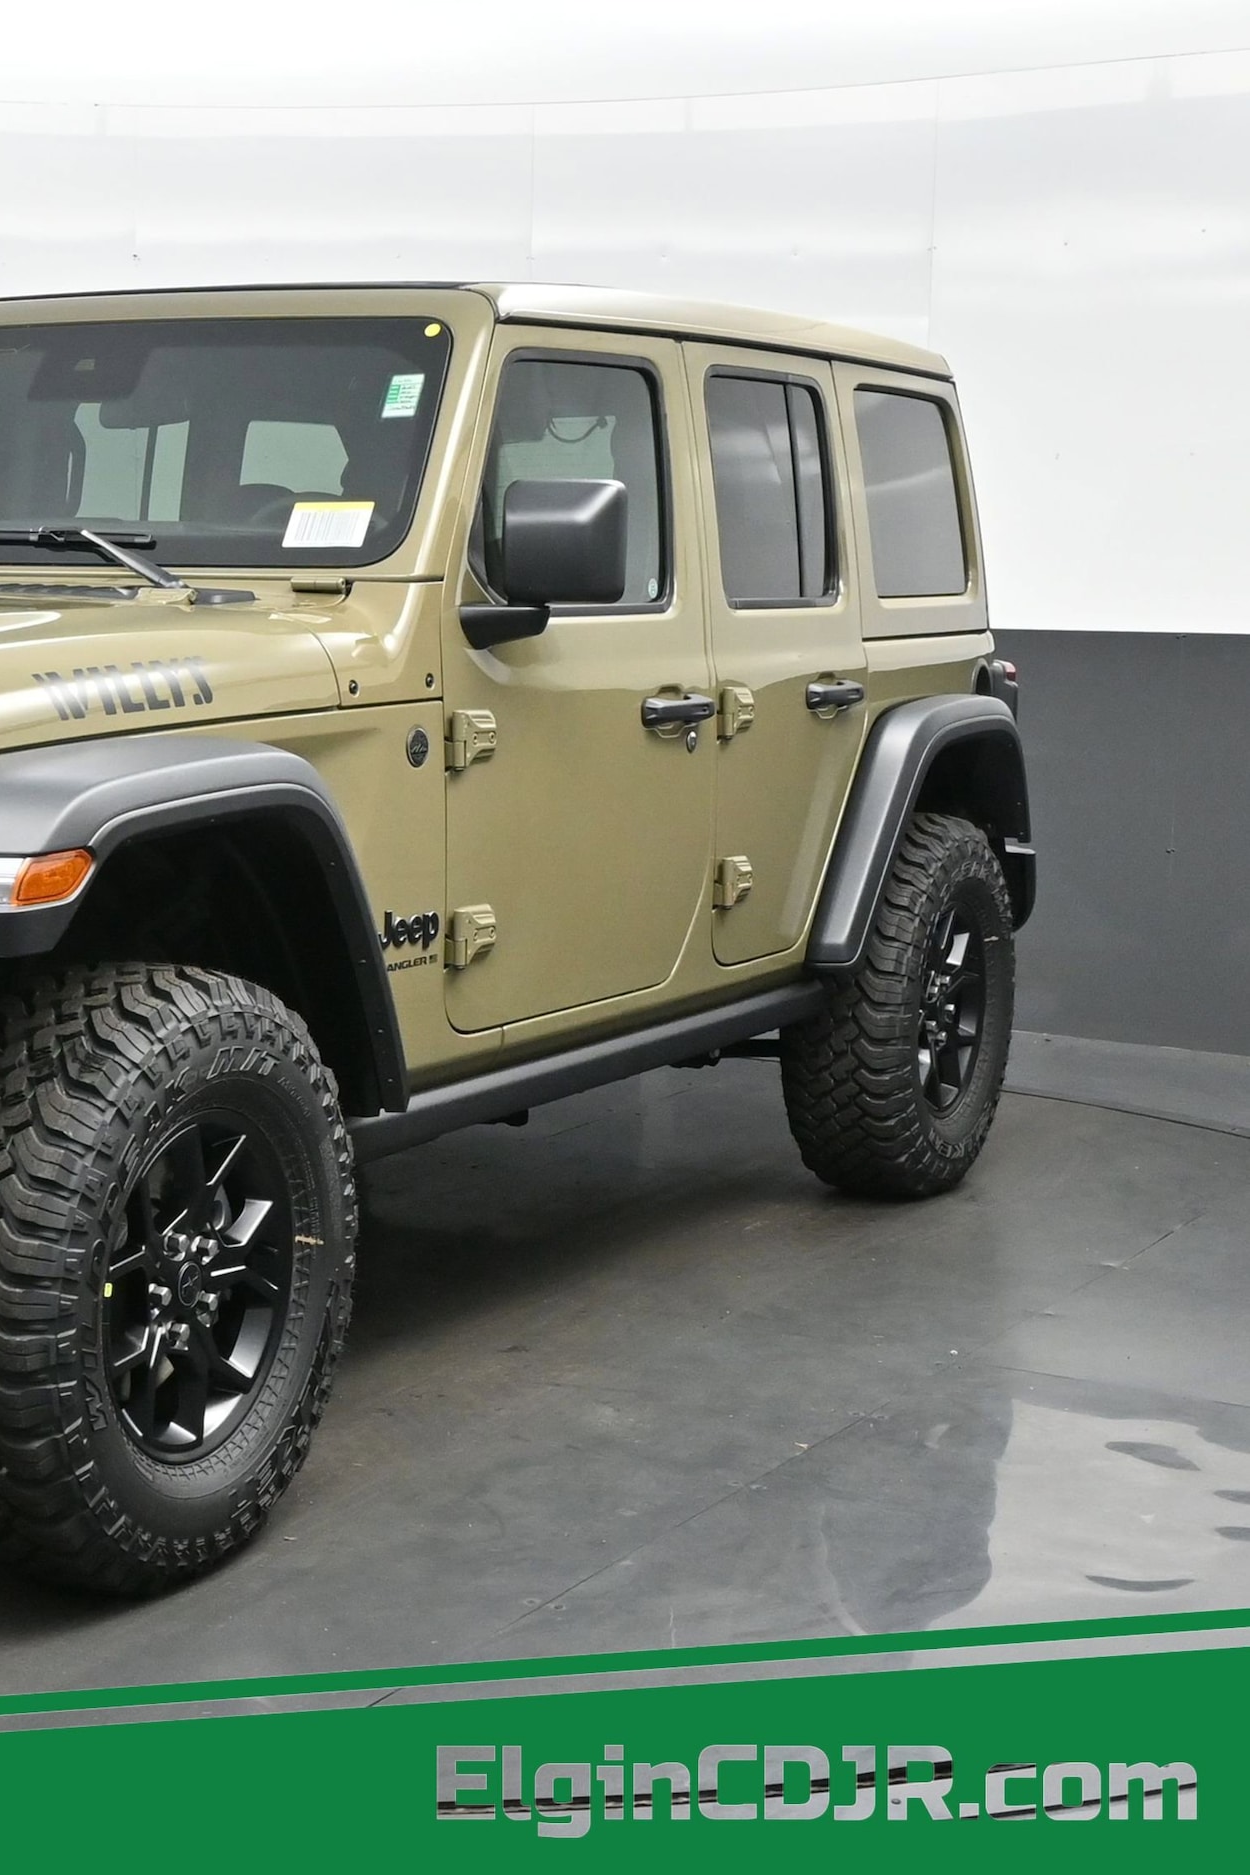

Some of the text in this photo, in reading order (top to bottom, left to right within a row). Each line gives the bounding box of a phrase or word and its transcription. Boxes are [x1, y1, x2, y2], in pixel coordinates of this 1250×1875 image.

[31, 656, 213, 720] WILLYS
[378, 909, 439, 950] Jeep
[387, 956, 427, 972] ANGLER
